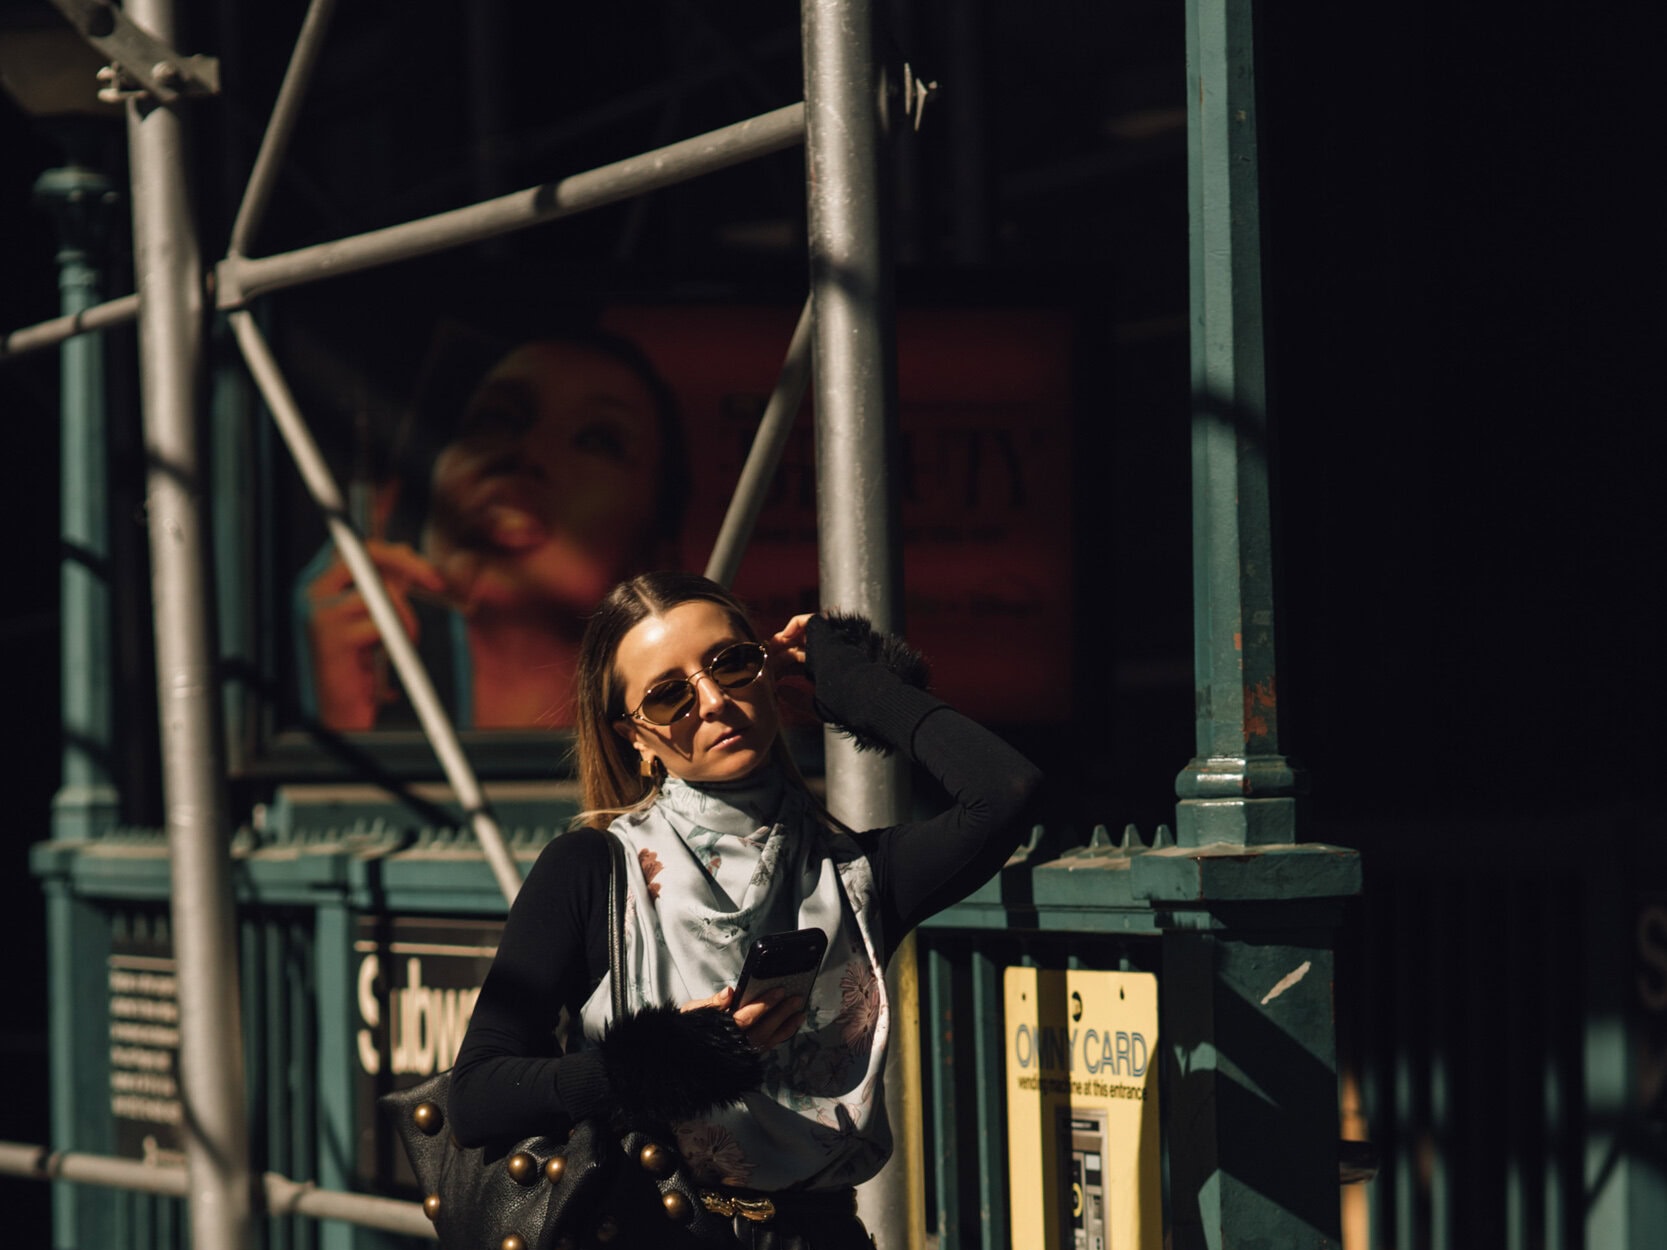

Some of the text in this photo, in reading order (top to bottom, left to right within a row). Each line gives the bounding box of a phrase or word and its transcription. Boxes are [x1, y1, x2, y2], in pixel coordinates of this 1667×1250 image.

[1016, 1024, 1147, 1078] OMNY CARD
[1018, 1074, 1147, 1100] vending machine at this entrance
